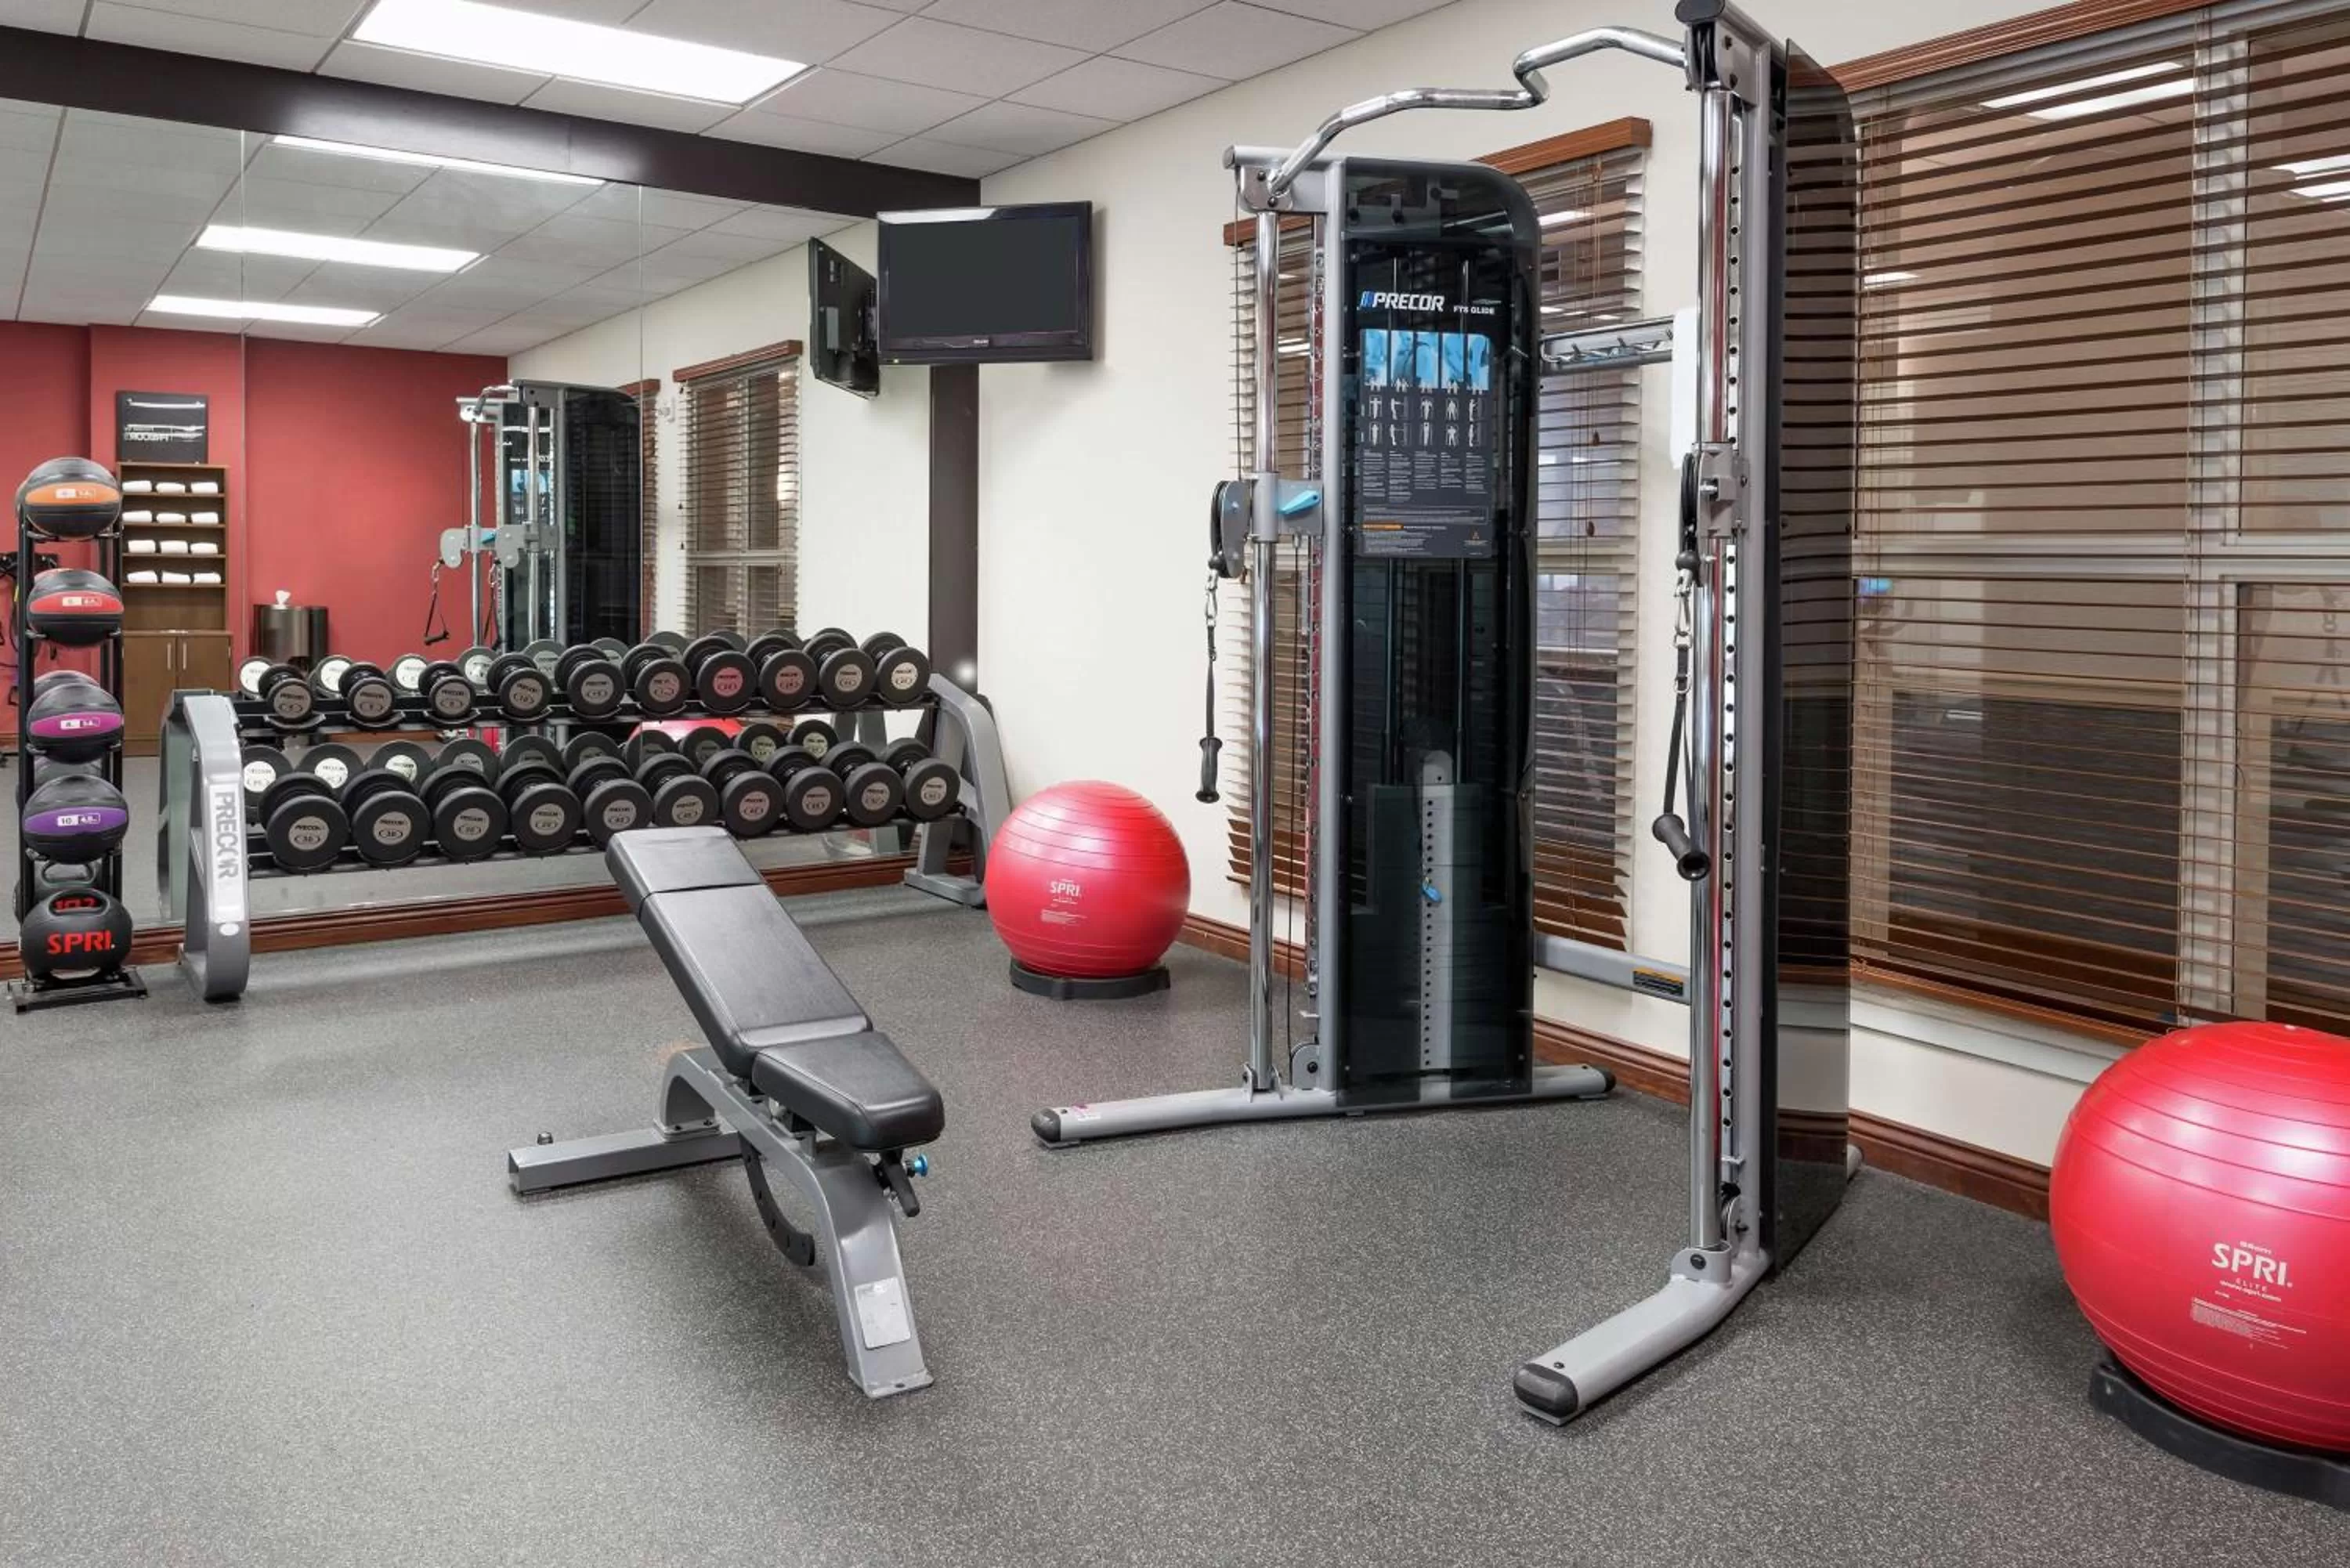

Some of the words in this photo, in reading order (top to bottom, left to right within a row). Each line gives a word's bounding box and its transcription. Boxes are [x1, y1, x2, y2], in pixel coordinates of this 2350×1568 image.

[1372, 291, 1444, 312] PRECOR
[215, 793, 239, 879] PRECOR
[1050, 881, 1080, 897] SPRI
[48, 930, 112, 955] SPRI
[2211, 1242, 2287, 1286] SPRI
